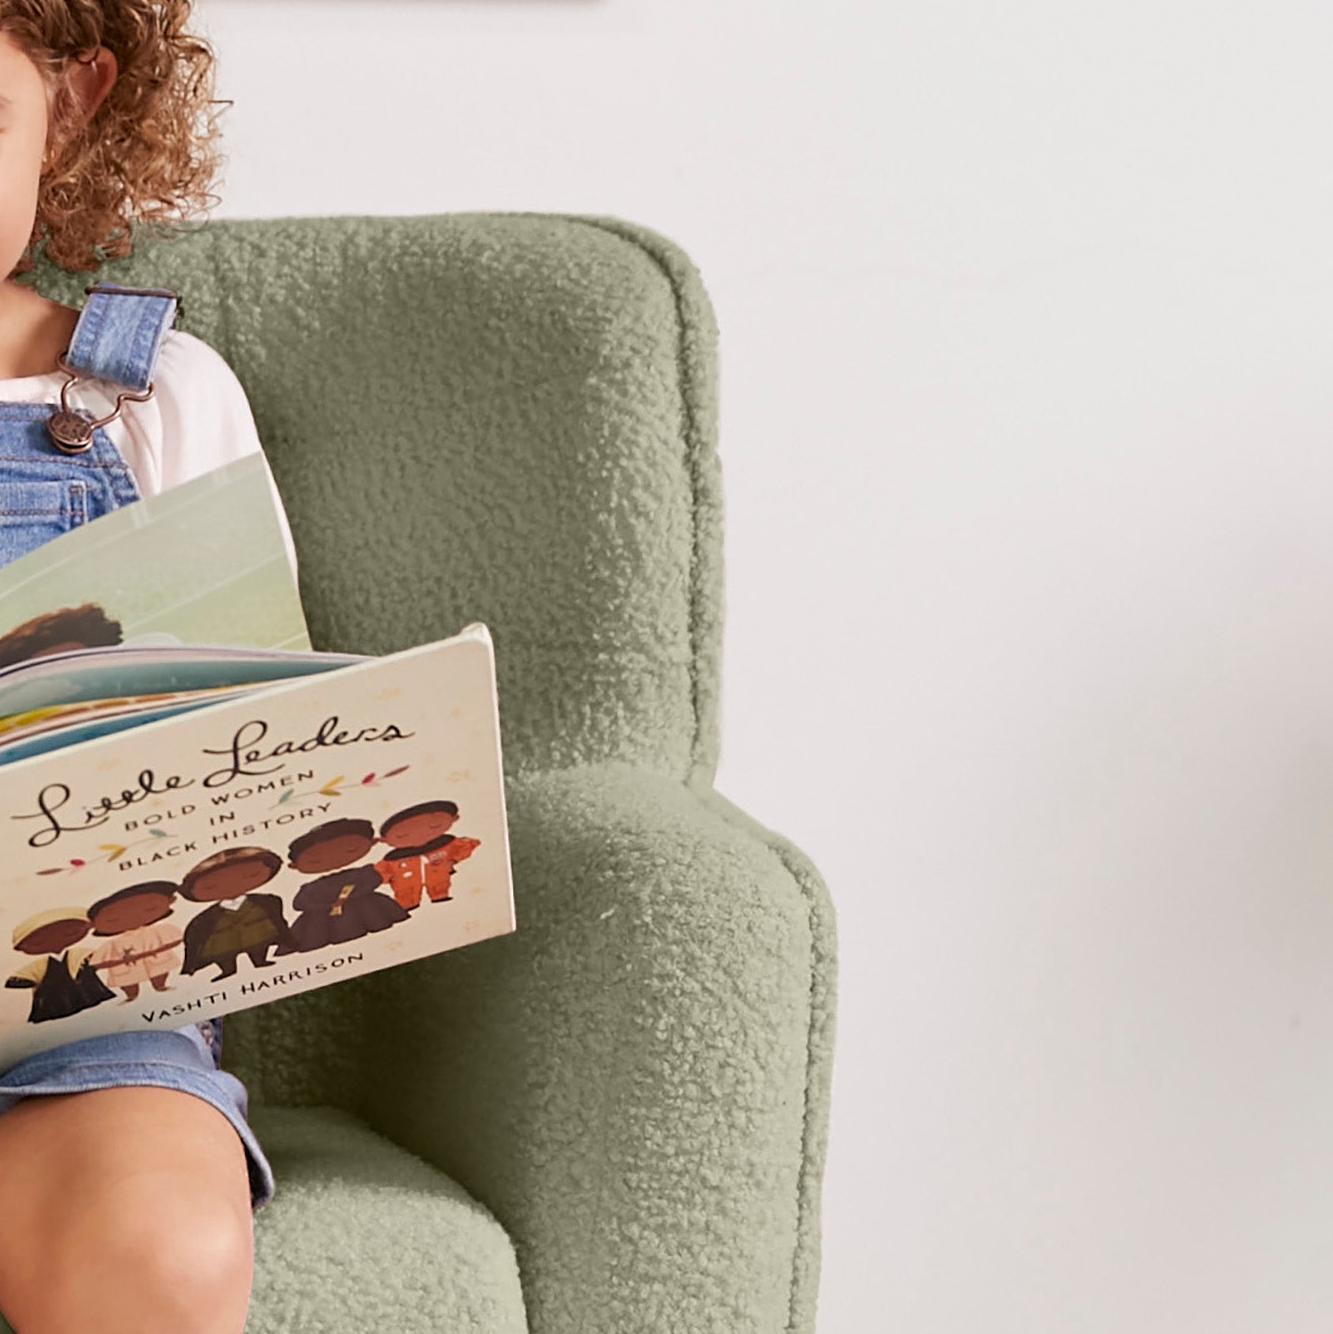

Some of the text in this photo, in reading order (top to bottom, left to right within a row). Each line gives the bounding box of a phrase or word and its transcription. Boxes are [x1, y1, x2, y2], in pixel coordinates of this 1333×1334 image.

[10, 716, 416, 848] Little Leaders
[124, 770, 315, 833] BOLD WOMEN
[119, 802, 333, 872] BLACK HISTORY
[209, 810, 236, 827] IN
[142, 952, 365, 1023] VASHTI HARRISON
